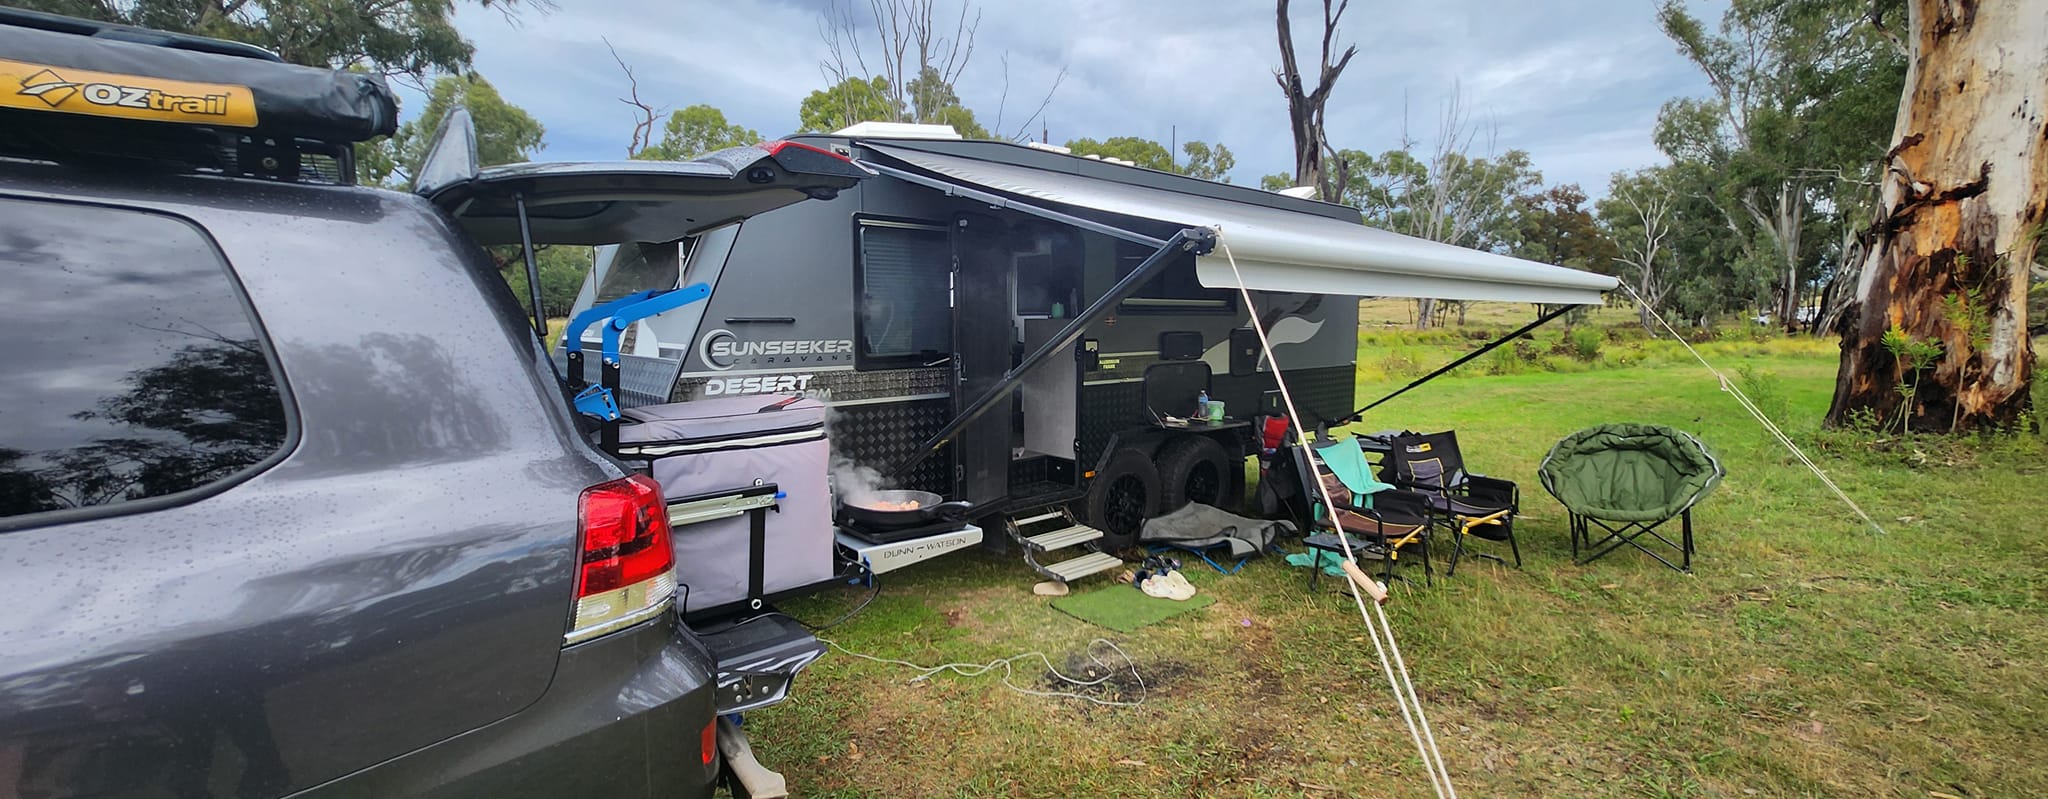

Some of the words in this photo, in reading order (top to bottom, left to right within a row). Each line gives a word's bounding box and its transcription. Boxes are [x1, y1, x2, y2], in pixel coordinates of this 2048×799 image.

[83, 82, 228, 116] OZtrail
[711, 340, 852, 357] SUNSEEKER
[733, 355, 852, 364] CARAVANS
[704, 374, 814, 396] DESERT
[883, 547, 914, 559] DUNN
[926, 538, 967, 550] WATSON
